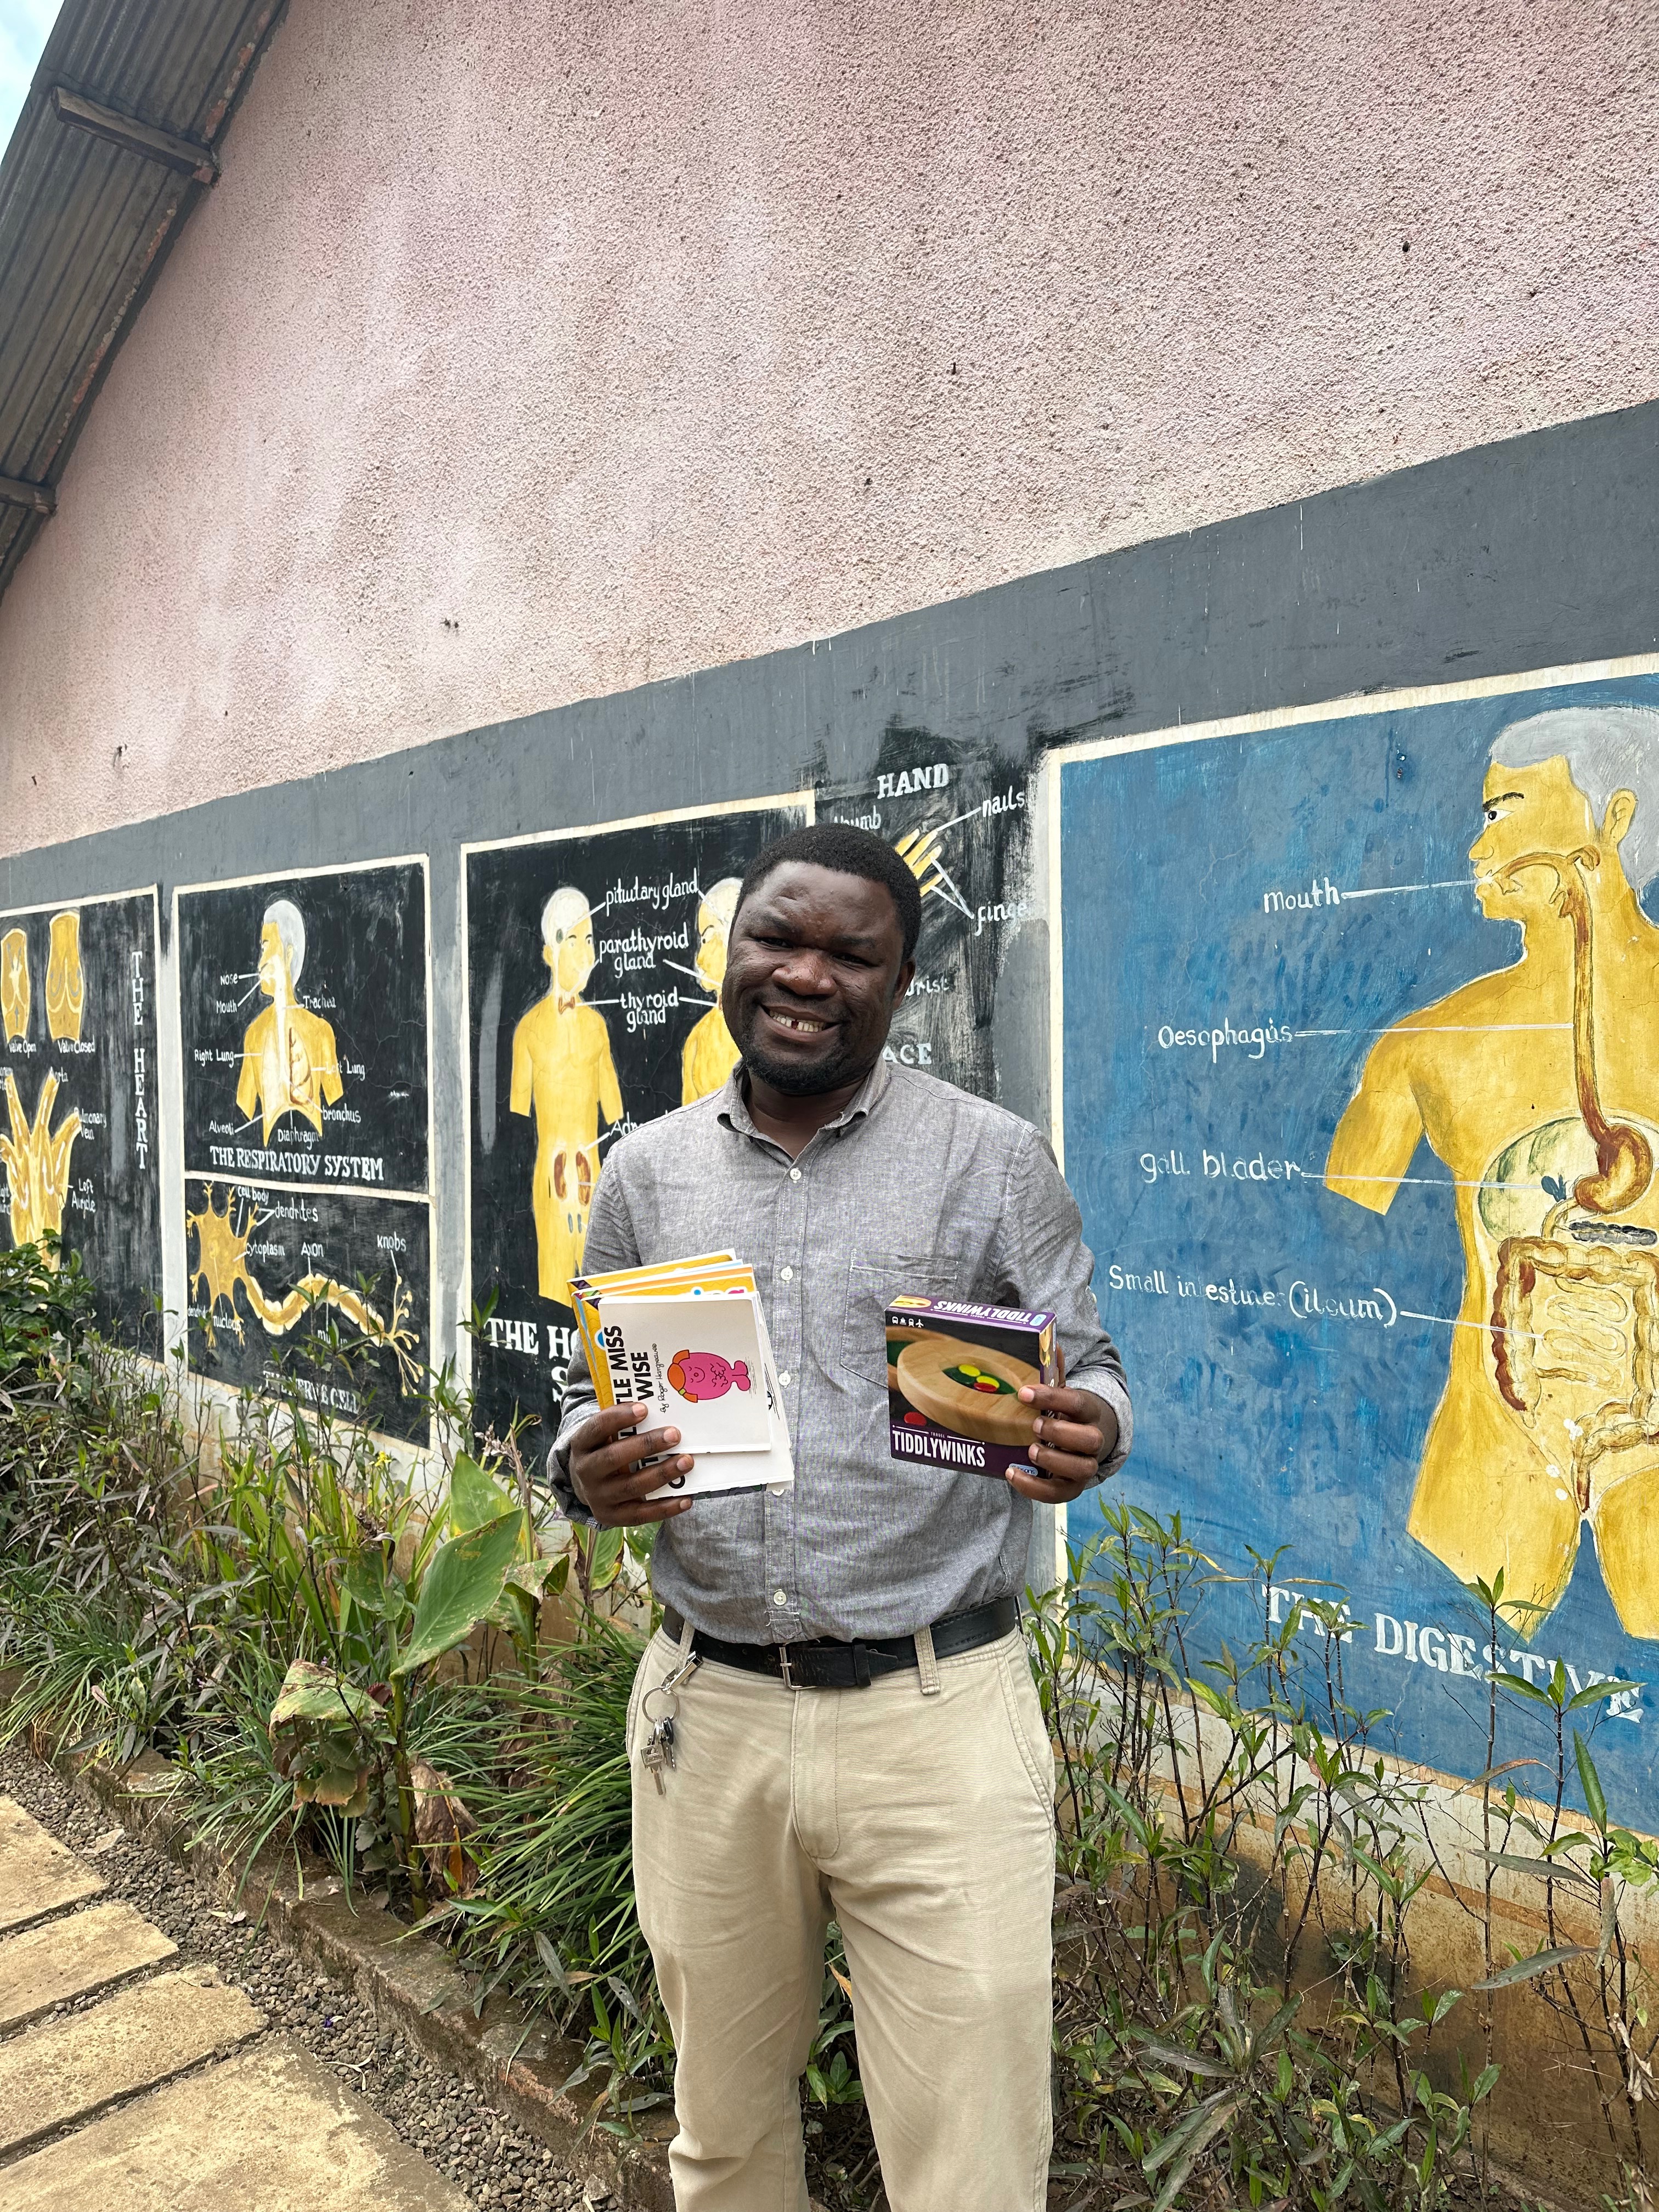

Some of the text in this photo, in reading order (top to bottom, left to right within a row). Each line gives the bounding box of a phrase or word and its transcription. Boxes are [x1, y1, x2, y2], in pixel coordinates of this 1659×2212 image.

[877, 764, 949, 799] HAND
[982, 785, 1025, 817] nails
[662, 867, 698, 910] gland
[600, 922, 689, 963] parathyroid
[614, 951, 657, 979] gland
[216, 999, 237, 1014] Mouth
[303, 994, 336, 1009] Trachea
[620, 986, 679, 1009] thyroid
[627, 1005, 666, 1032] gland
[132, 951, 148, 1170] THE HEART
[194, 1048, 234, 1068] Right Lung
[883, 1043, 932, 1064] ACE
[346, 1058, 366, 1081] Lung
[323, 1103, 362, 1124] bronchus
[209, 1120, 234, 1135] Alveoli
[210, 1145, 385, 1181] THE RESPIRATORY SYSTEM
[252, 1186, 269, 1206] body
[275, 1197, 319, 1222] dendrites
[1108, 1264, 1169, 1295] Small
[933, 1301, 1032, 1323] TIDDLYWINKS
[483, 1317, 539, 1355] THE
[604, 1325, 629, 1371] MISS
[630, 1352, 654, 1401] WISE
[892, 1430, 986, 1468] TIDDLYWINKS
